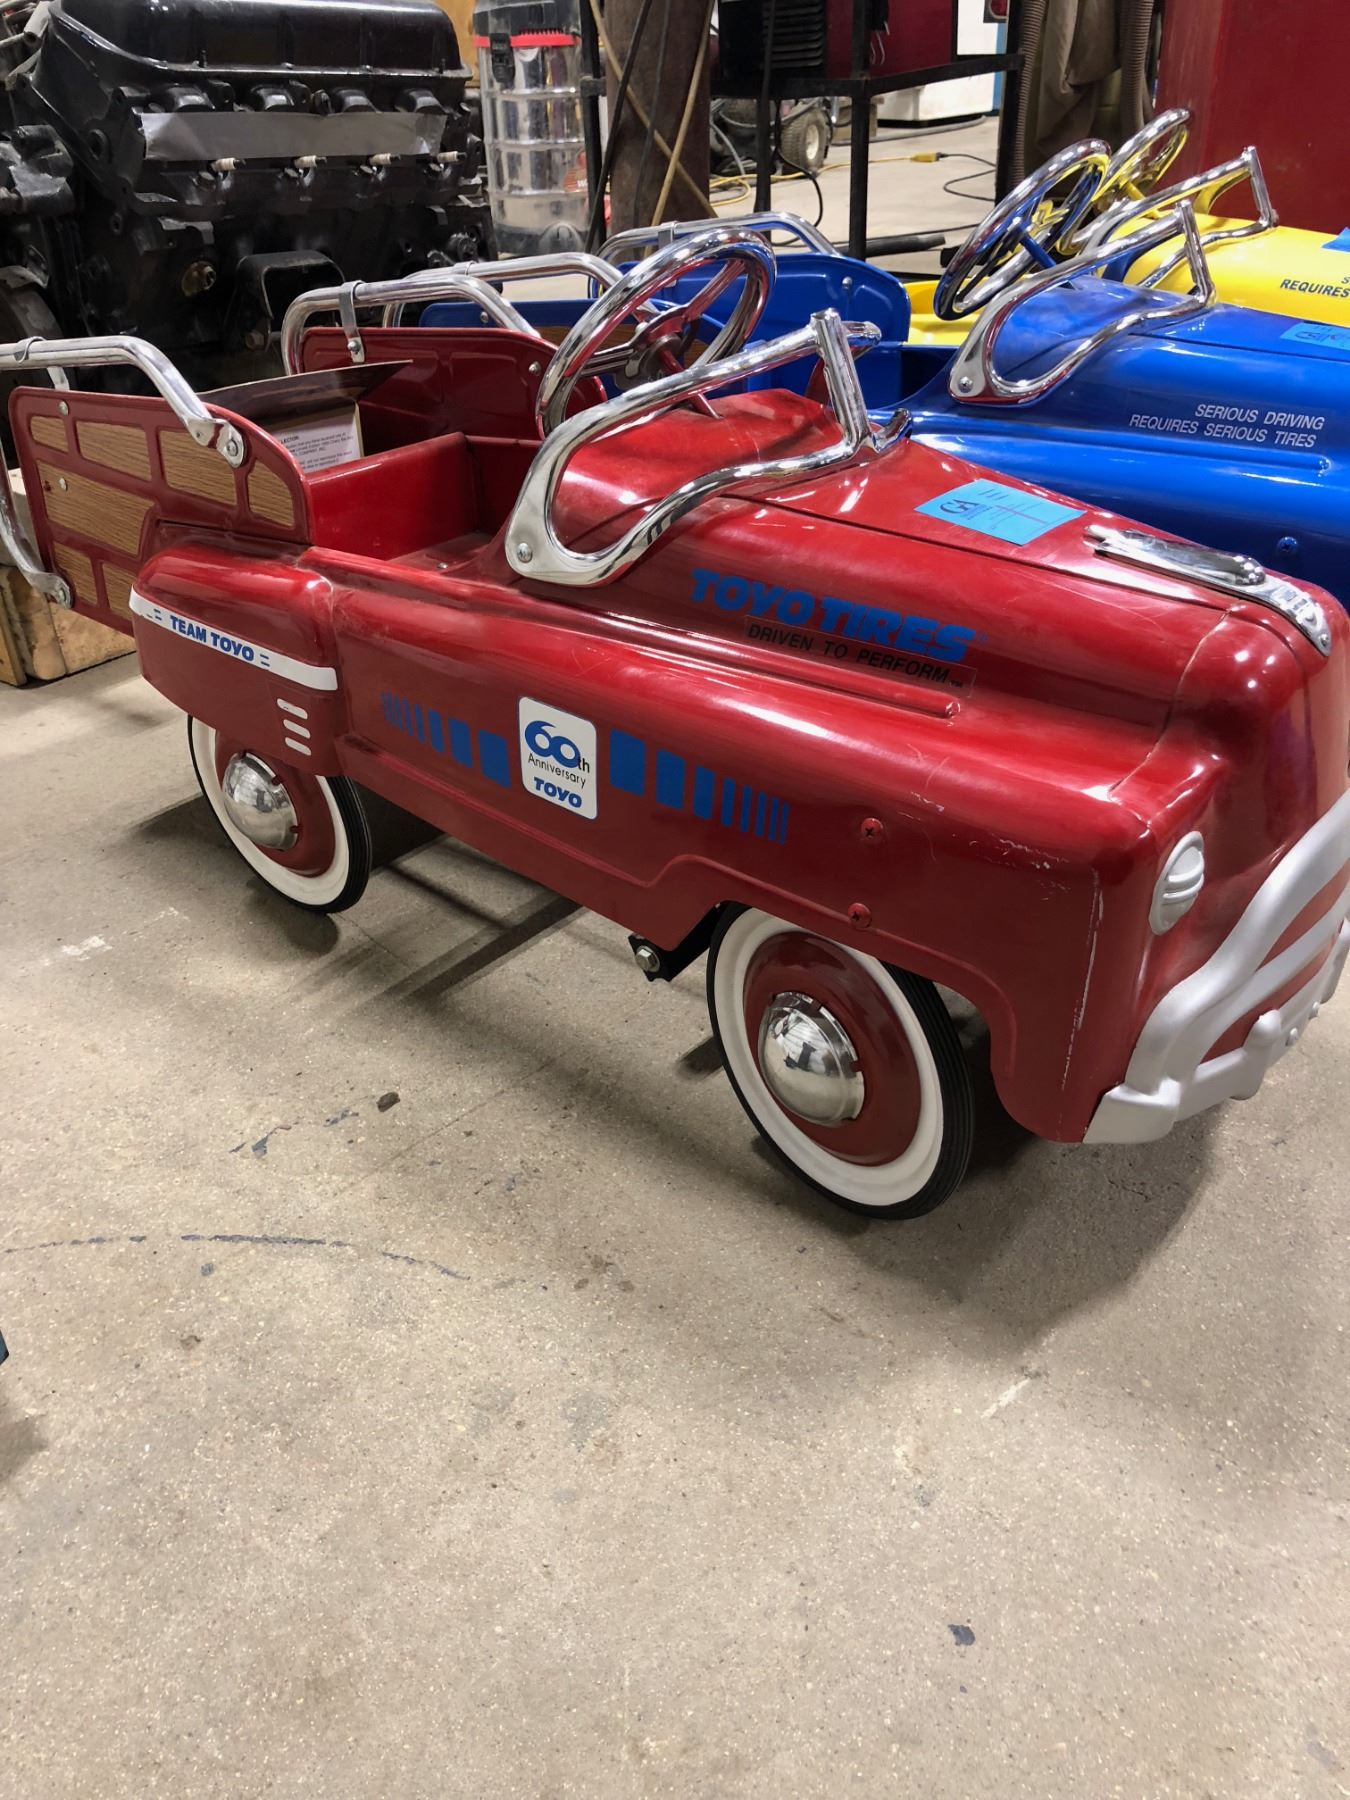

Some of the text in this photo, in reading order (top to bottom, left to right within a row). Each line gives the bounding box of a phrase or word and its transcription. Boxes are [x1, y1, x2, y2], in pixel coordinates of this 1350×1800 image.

[1280, 278, 1350, 298] REQUIRES
[1129, 414, 1317, 448] REQUIRES SERIOUS TIRES
[1195, 404, 1325, 431] SERIOUS DRIVING
[691, 568, 976, 663] TOYO TIRES
[170, 615, 255, 661] TEAM TOYO
[747, 623, 951, 684] DRIVEN TO PERFORM
[528, 753, 586, 789] Anniversary
[533, 776, 583, 808] TOYO
